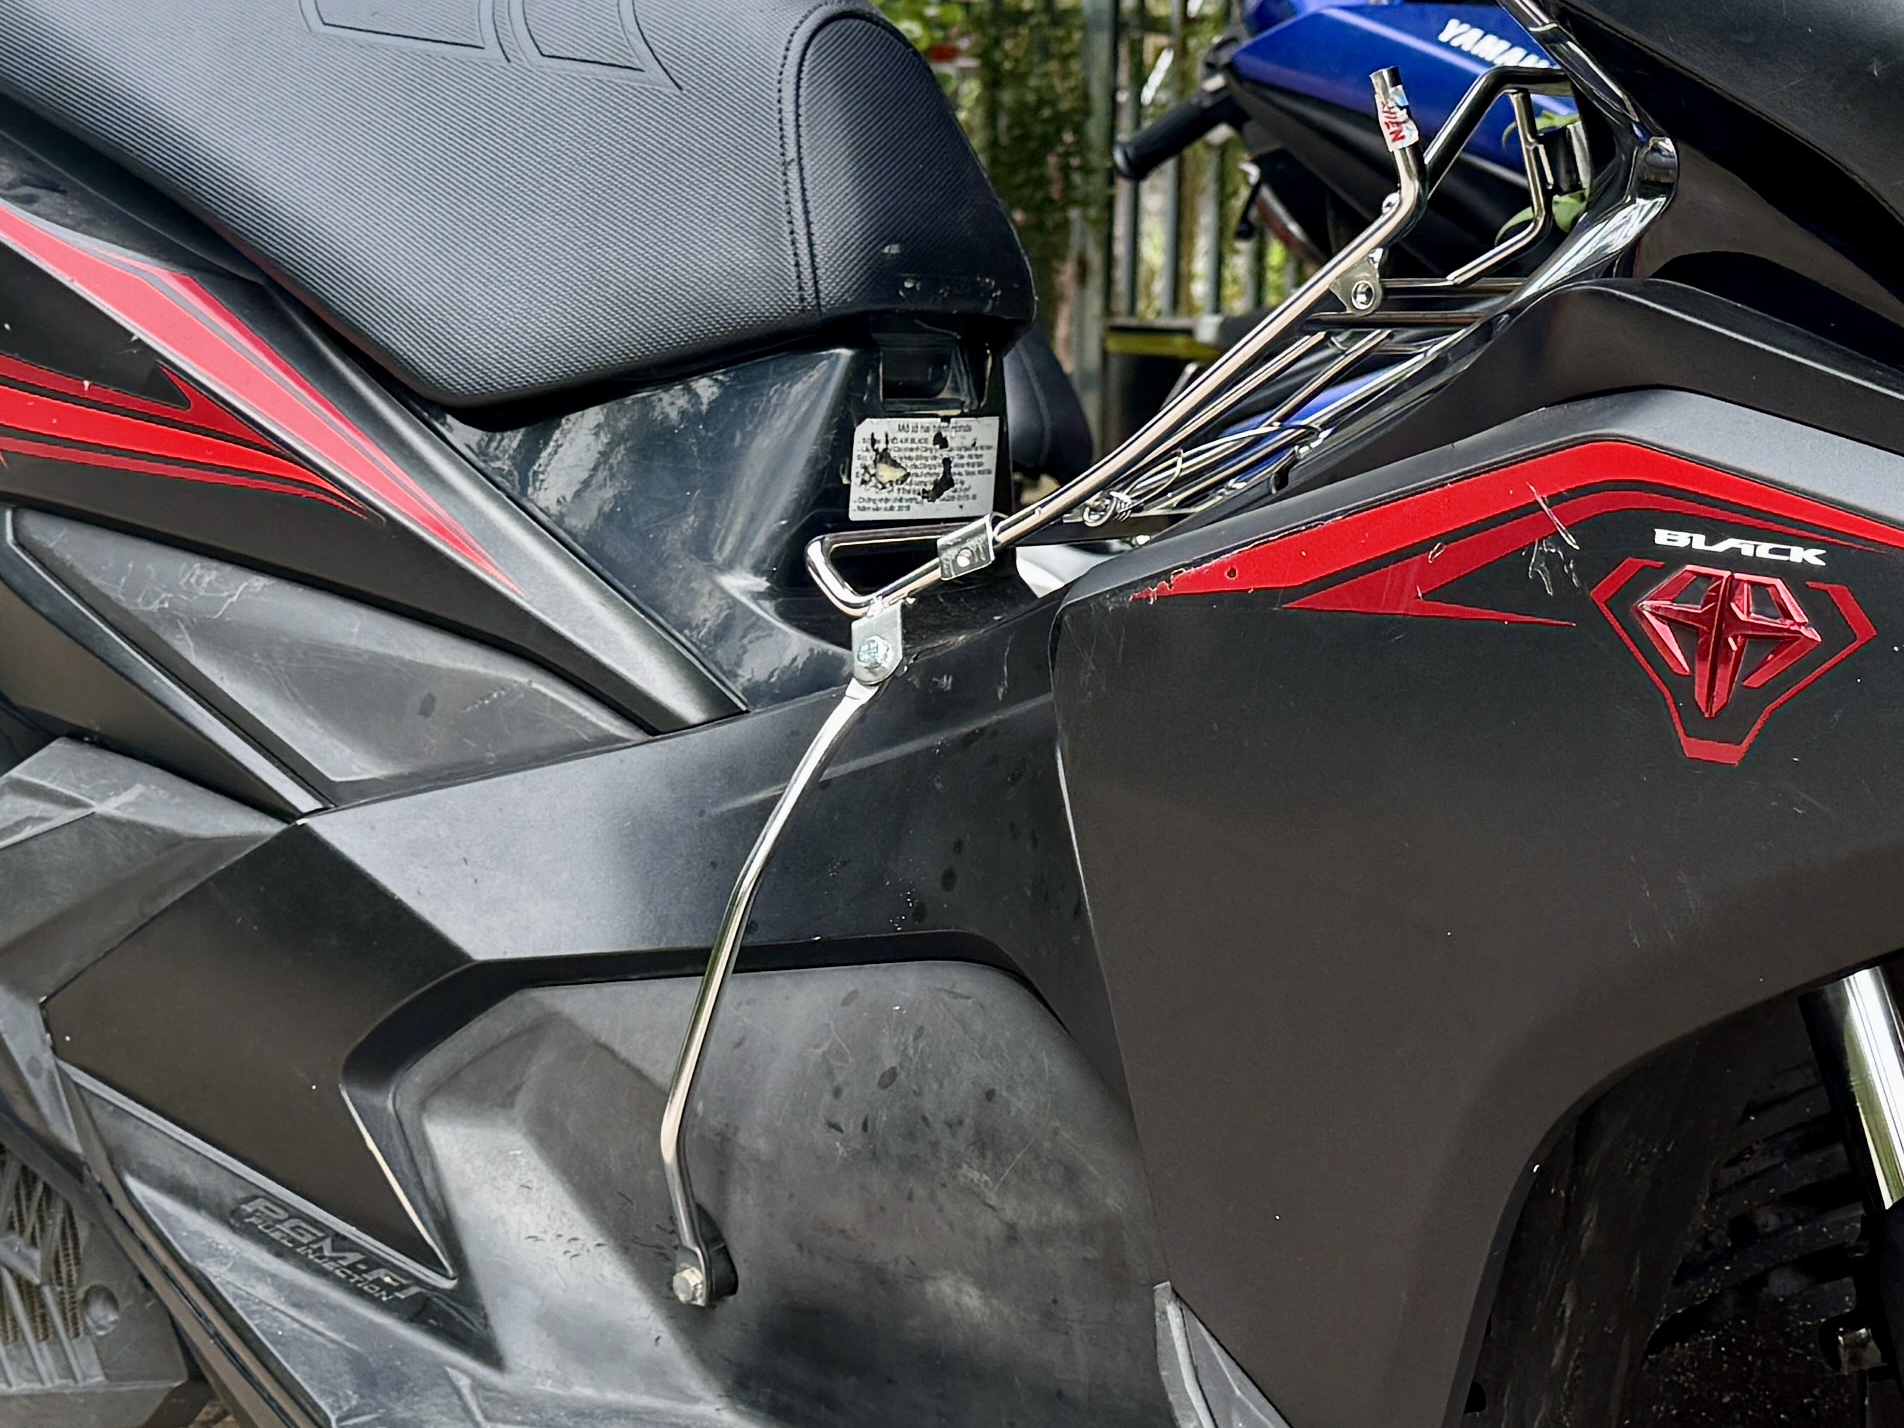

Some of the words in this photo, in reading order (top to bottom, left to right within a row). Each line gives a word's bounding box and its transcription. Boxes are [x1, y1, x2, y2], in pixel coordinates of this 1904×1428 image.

[1653, 528, 1827, 566] BLACK
[246, 1216, 295, 1249] FUEL
[297, 1245, 396, 1302] INJECTION
